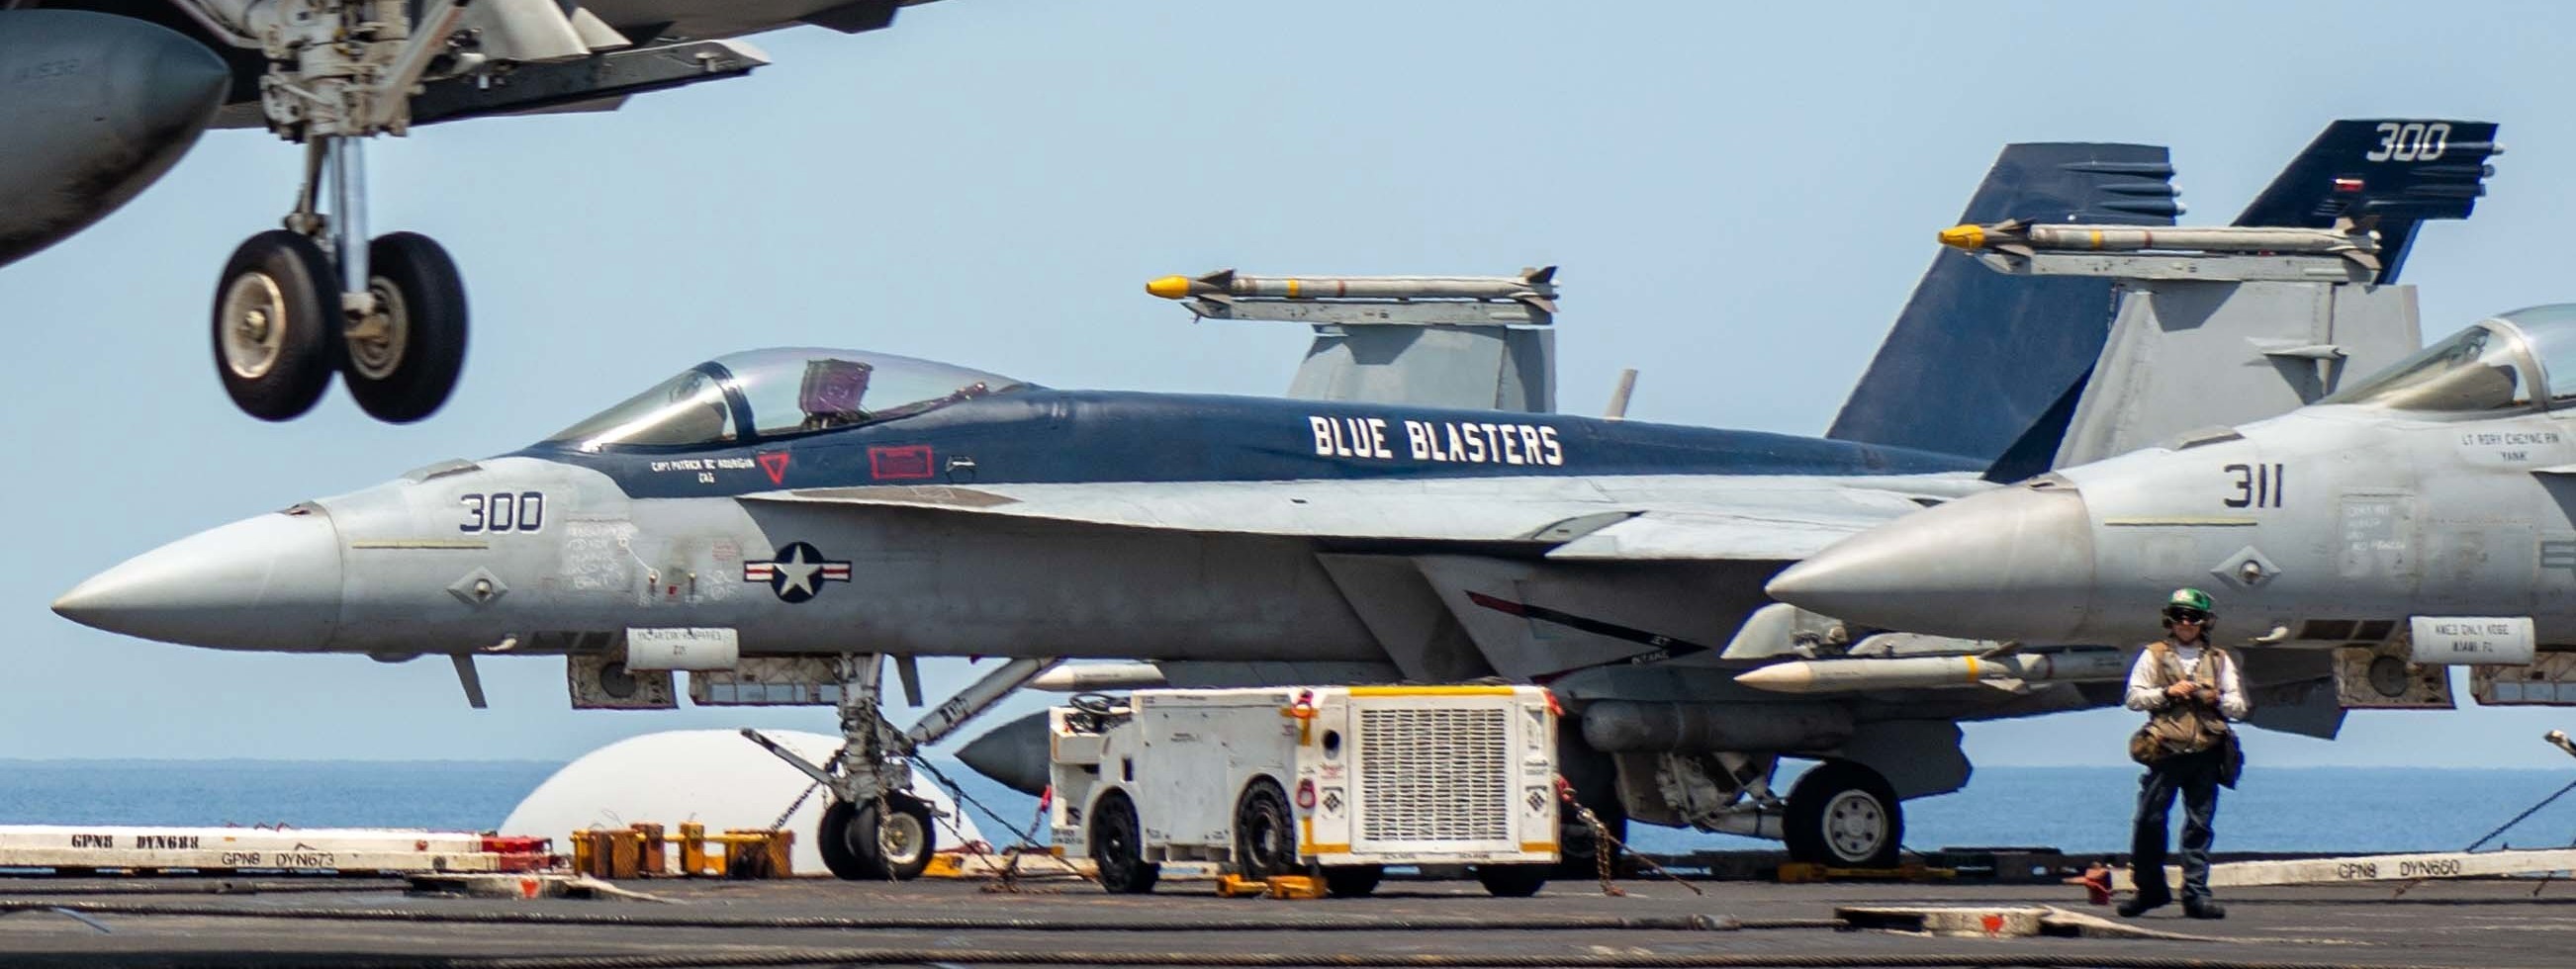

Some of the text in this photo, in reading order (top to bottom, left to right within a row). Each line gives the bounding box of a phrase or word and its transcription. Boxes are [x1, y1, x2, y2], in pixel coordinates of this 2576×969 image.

[2366, 123, 2450, 161] 300
[1308, 415, 1564, 466] BLUE BLASTERS
[2223, 463, 2283, 508] 311
[459, 490, 546, 535] 300
[222, 852, 334, 866] GPN8 DYN673
